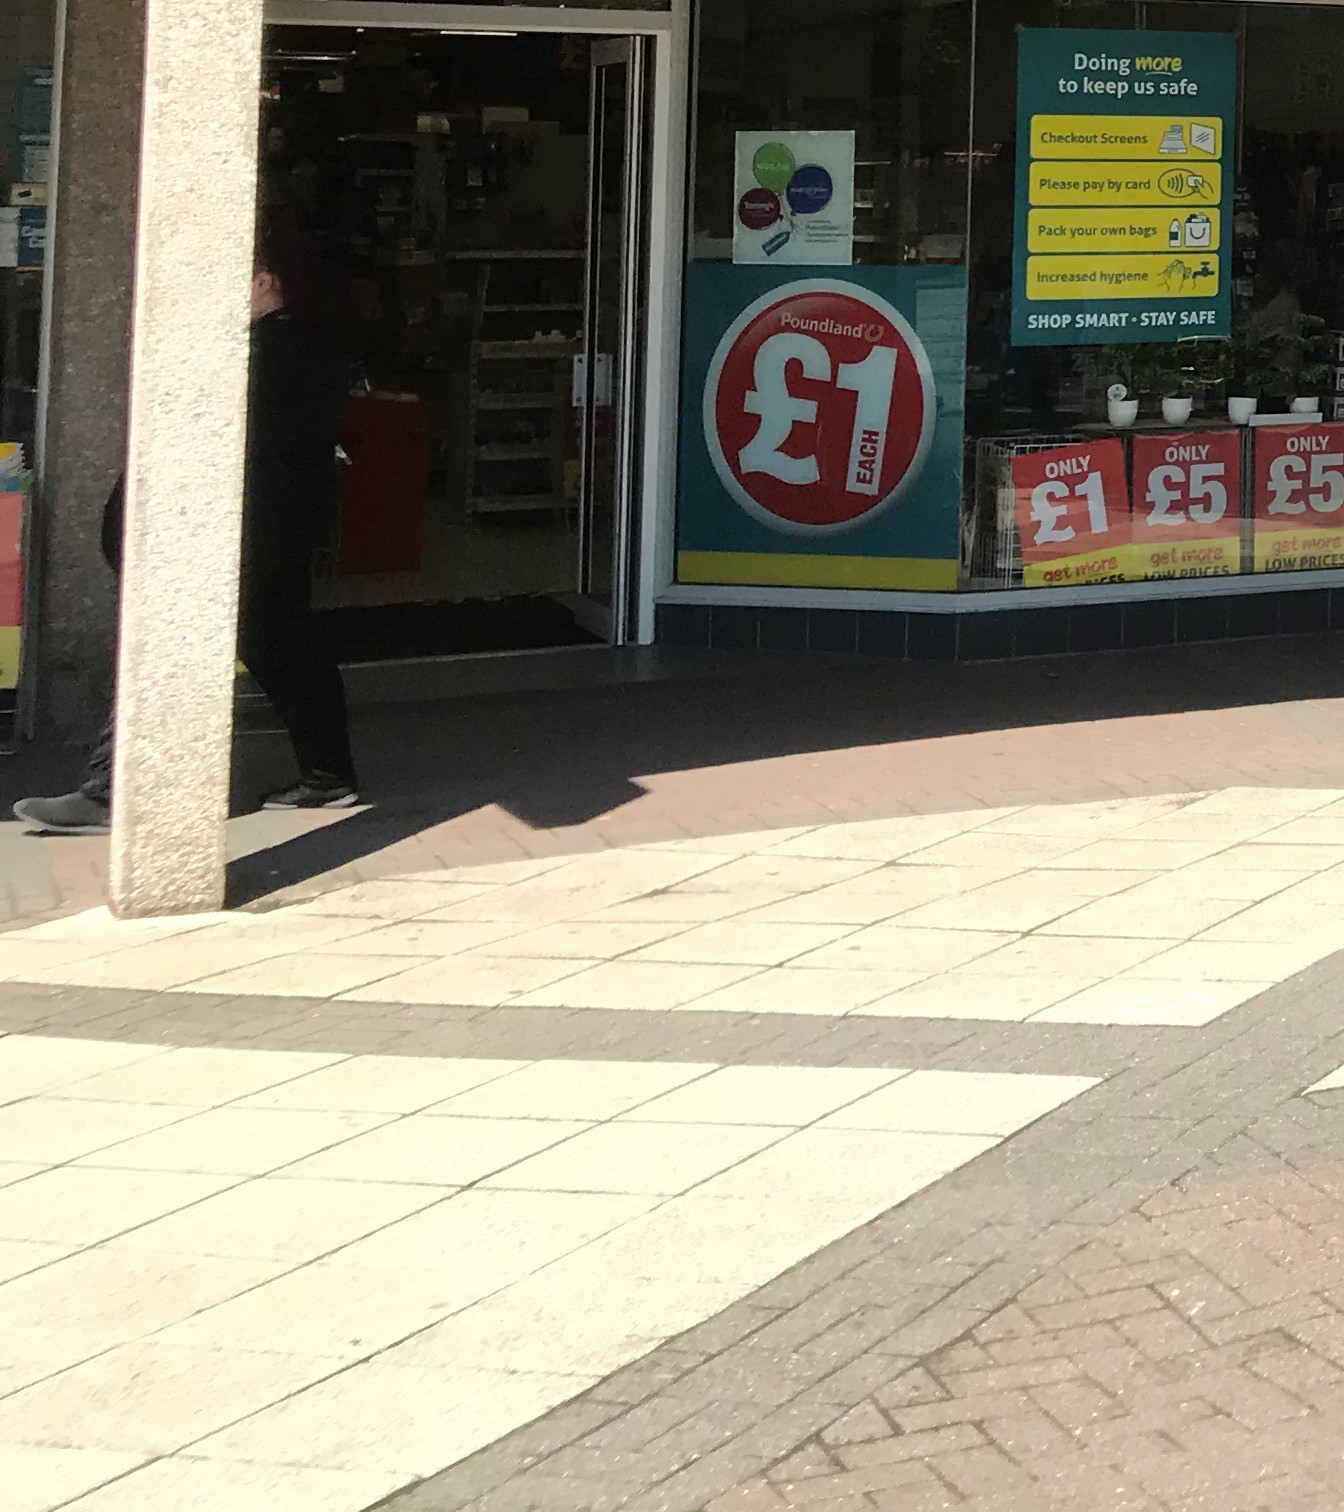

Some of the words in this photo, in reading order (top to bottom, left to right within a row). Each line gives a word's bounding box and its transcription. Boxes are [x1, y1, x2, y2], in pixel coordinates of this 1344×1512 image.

[1074, 53, 1131, 76] Doing
[1135, 55, 1183, 73] more
[1058, 78, 1078, 94] to
[1083, 77, 1129, 99] keep
[1134, 82, 1155, 95] us
[1159, 79, 1198, 96] safe
[1041, 131, 1098, 144] Checkout
[1101, 132, 1148, 144] Screens
[1039, 178, 1080, 191] Please
[1083, 180, 1105, 193] pay
[1107, 178, 1122, 193] by
[1125, 178, 1151, 190] card
[1038, 225, 1067, 237] Pack
[1070, 227, 1097, 238] your
[1100, 226, 1126, 236] own
[1129, 225, 1158, 238] bags
[1037, 271, 1097, 283] Increased
[1099, 270, 1149, 285] hygiene
[780, 311, 864, 340] Poundland
[1027, 314, 1072, 329] SHOP
[1074, 312, 1130, 329] SMART
[1139, 311, 1177, 327] STAY
[1179, 310, 1216, 326] SAFE
[738, 331, 898, 497] £1
[1164, 444, 1210, 463] ONLY
[1286, 435, 1330, 453] ONLY
[855, 428, 880, 486] EACH
[1045, 454, 1091, 479] ONLY
[1145, 462, 1228, 527] £5
[1030, 471, 1109, 546] £1
[1271, 537, 1298, 555] get
[1302, 535, 1342, 550] more
[1150, 548, 1178, 567] get
[1181, 546, 1224, 562] more
[1264, 556, 1297, 572] LOW
[1042, 564, 1072, 583] get
[1075, 554, 1119, 577] more
